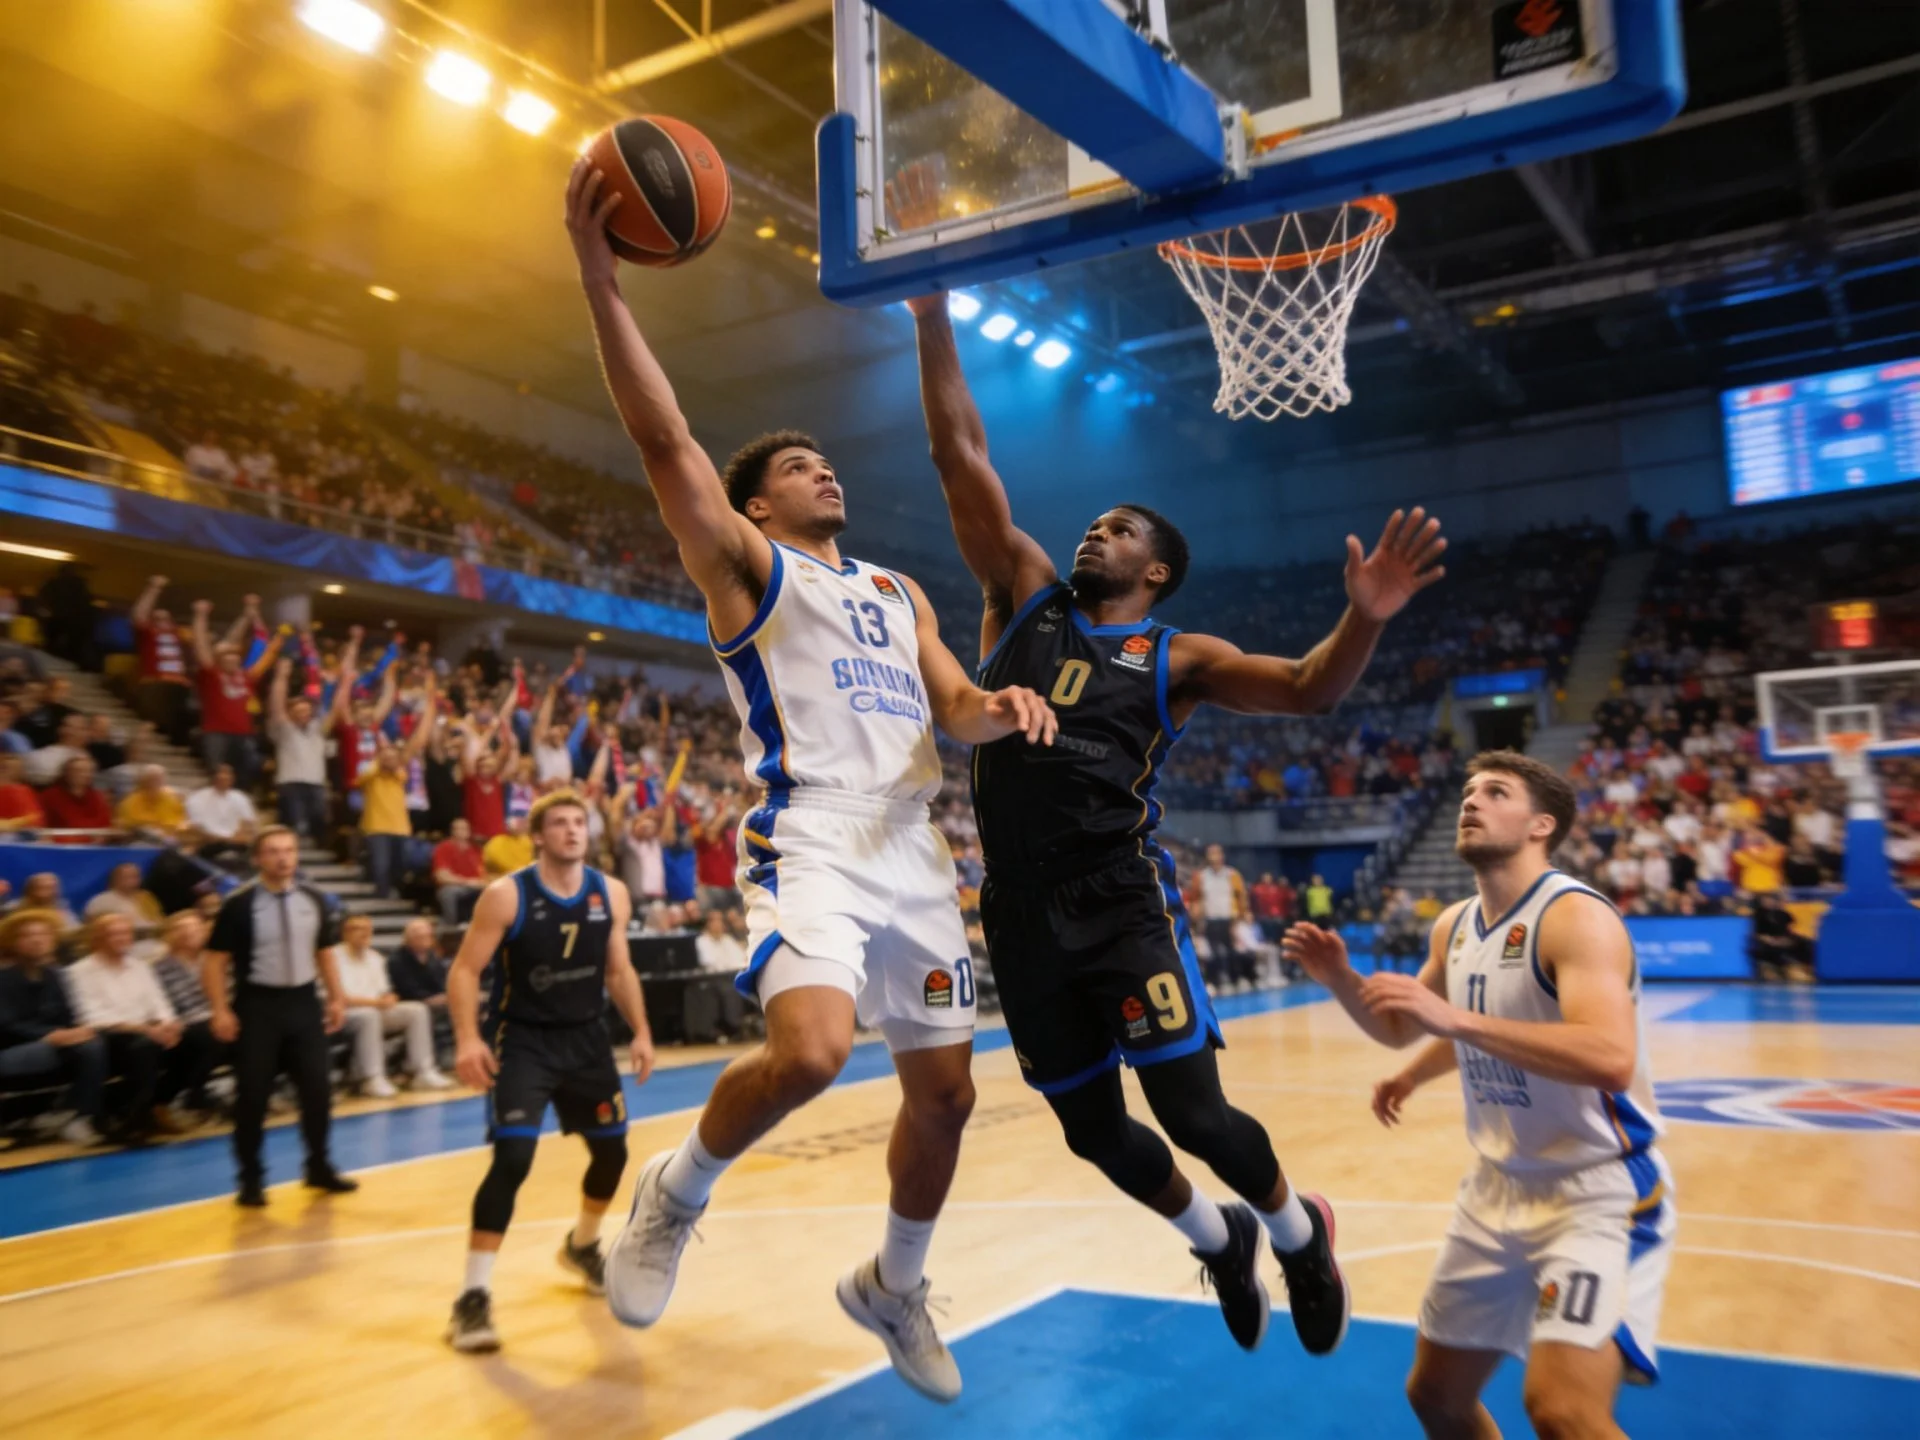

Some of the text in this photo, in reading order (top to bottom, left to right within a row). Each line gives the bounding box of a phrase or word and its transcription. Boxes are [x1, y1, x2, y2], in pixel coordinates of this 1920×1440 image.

[842, 599, 890, 648] 13
[1051, 659, 1092, 706] 0
[560, 923, 579, 959] 7
[1146, 972, 1188, 1031] 9
